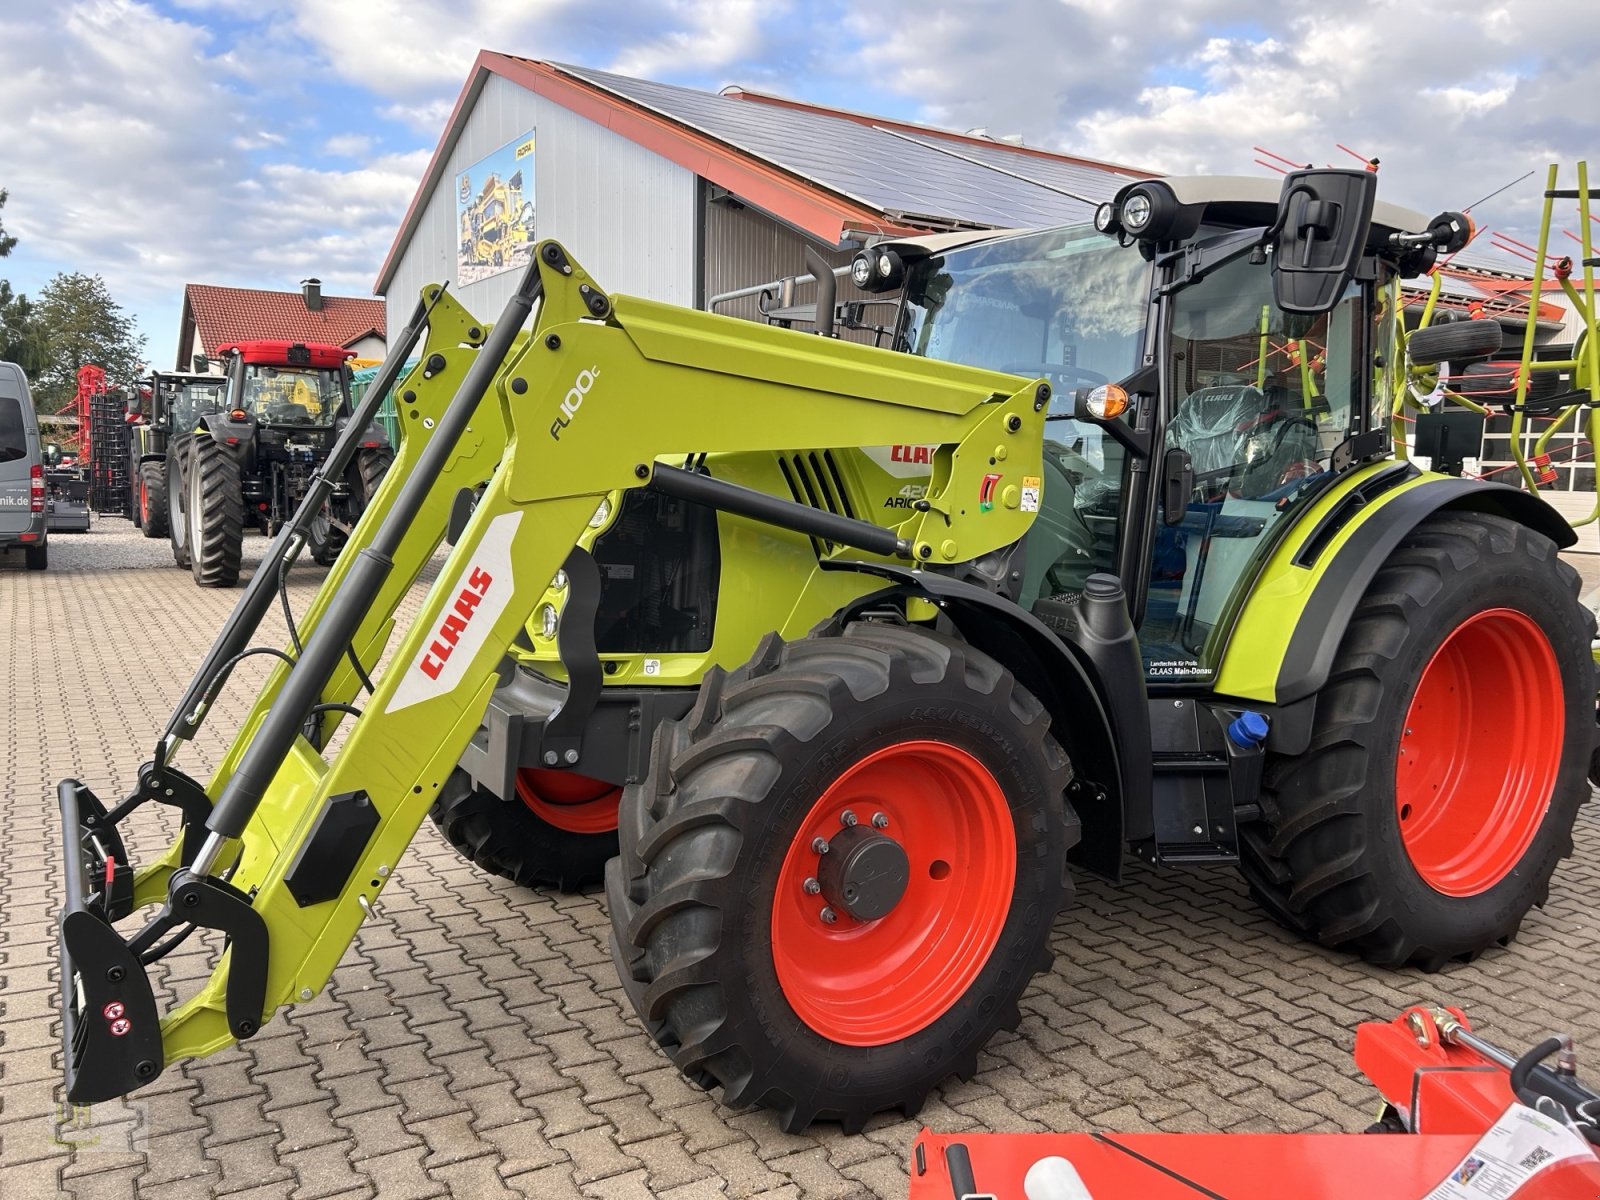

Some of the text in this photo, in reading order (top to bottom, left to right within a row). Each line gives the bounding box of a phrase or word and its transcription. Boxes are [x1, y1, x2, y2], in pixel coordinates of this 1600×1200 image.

[517, 143, 531, 158] ROPA
[891, 445, 936, 464] CLA
[884, 497, 917, 509] ARIO
[420, 566, 493, 681] CLAAS
[1149, 667, 1212, 675] CLAAS Main-Donau
